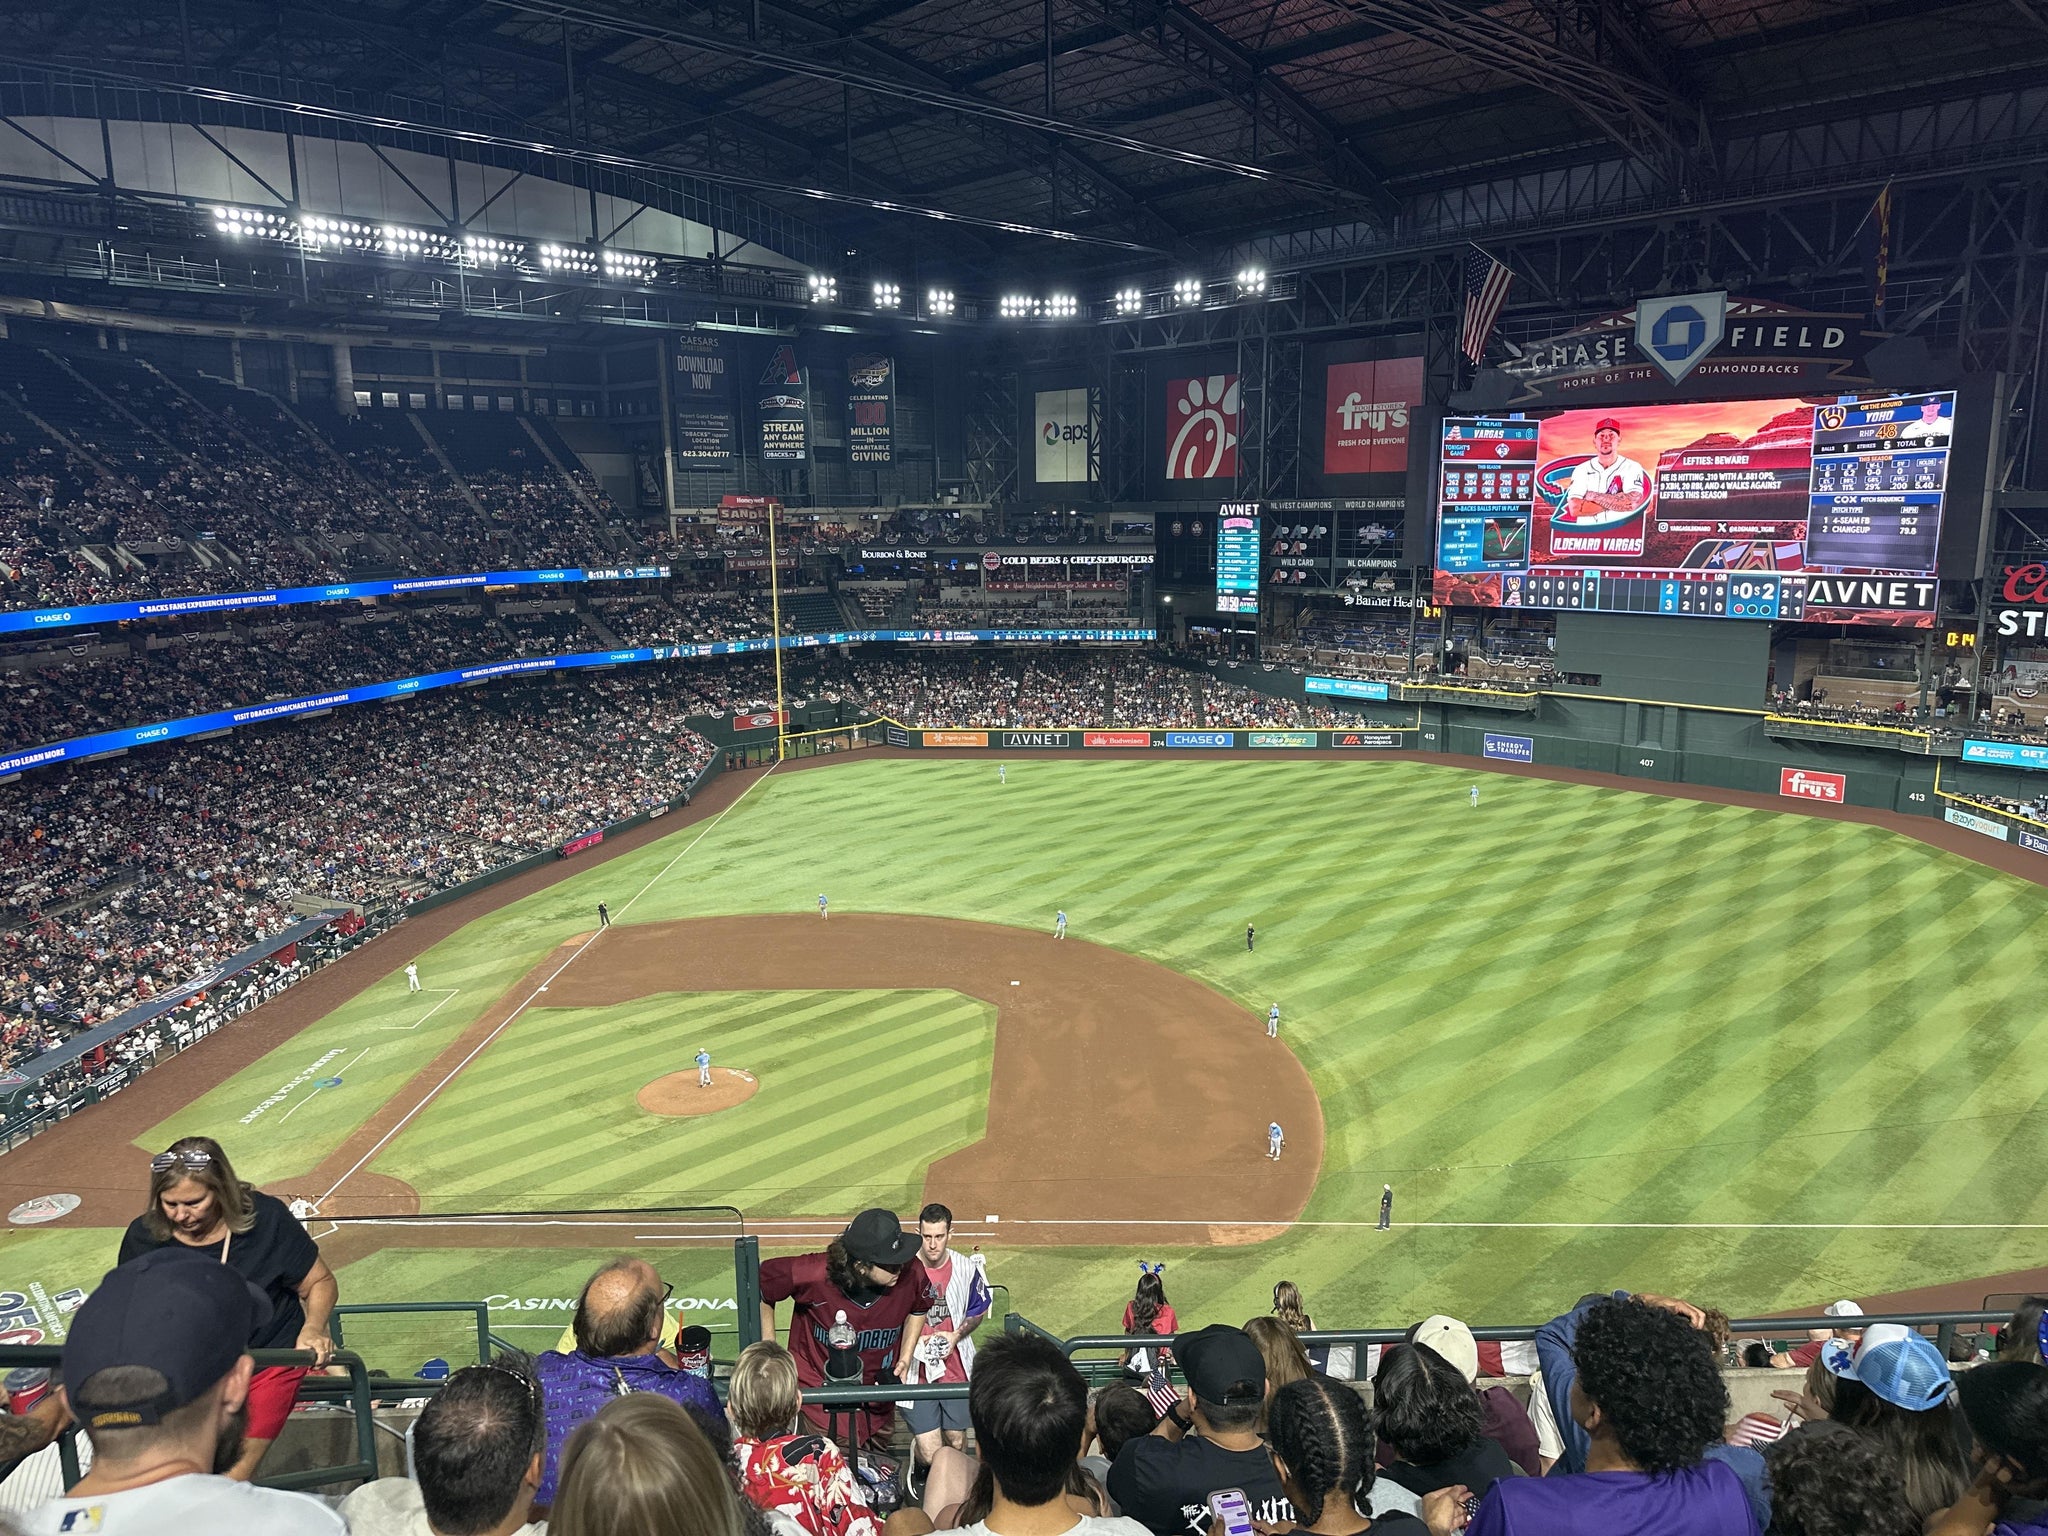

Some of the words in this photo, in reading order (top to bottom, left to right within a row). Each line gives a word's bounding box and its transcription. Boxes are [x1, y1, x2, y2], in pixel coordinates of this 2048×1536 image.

[679, 336, 718, 347] CAESARS
[1531, 337, 1626, 369] CHASE
[1730, 326, 1845, 348] FIELD
[677, 355, 724, 374] DOWNLOAD
[691, 373, 712, 390] NOW
[1563, 377, 1596, 388] HOME
[1604, 373, 1619, 382] OF
[1630, 369, 1651, 379] THE
[1699, 364, 1799, 374] DIAMONDBACKS
[1337, 391, 1409, 433] fry's
[1866, 411, 1895, 423] YOHO
[762, 423, 805, 433] STREAM
[850, 427, 890, 436] MILLION
[1859, 429, 1874, 438] RHP
[1875, 424, 1898, 439] 48
[763, 433, 780, 441] ANY
[782, 433, 805, 441] GAME
[1062, 423, 1089, 445] aps
[1474, 429, 1505, 439] VARGAS
[1373, 437, 1406, 446] EVERYONE
[1843, 444, 1849, 453] 1
[1883, 440, 1891, 450] 5
[1924, 437, 1934, 447] 6
[851, 451, 891, 462] GIVING
[1683, 456, 1713, 466] LEFTIES:
[1714, 455, 1749, 465] BEWARE!
[1661, 473, 1670, 482] HE
[1678, 473, 1703, 482] HITTING
[1719, 472, 1737, 481] WITH
[1758, 471, 1775, 482] OPS,
[1682, 482, 1690, 490] 20
[1707, 481, 1719, 490] AND
[1726, 480, 1746, 490] WALKS
[1747, 480, 1781, 490] AGAINST
[1660, 491, 1684, 500] LEFTIES
[1684, 490, 1699, 499] THIS
[1700, 490, 1728, 499] SEASON
[736, 497, 765, 505] Honeywell
[1296, 501, 1333, 509] CHAMPIONS
[1367, 500, 1405, 508] CHAMPIONS
[1219, 504, 1260, 516] AVNET
[1831, 526, 1871, 534] CHANGEUP
[1553, 539, 1598, 552] ILDEMARO
[1602, 538, 1642, 551] VARGAS
[895, 550, 903, 559] &
[1002, 556, 1027, 565] COLD
[1029, 556, 1061, 565] BEERS
[1062, 556, 1069, 565] &
[1070, 555, 1154, 565] CHEESEBURGERS
[1281, 558, 1296, 567] WILD
[1297, 558, 1314, 566] CARD
[1356, 560, 1398, 568] CHAMPIONS
[588, 571, 604, 579] 8:13
[605, 570, 619, 578] PM
[1714, 573, 1727, 581] LOB
[1529, 580, 1536, 590] 0
[1543, 581, 1550, 590] 0
[1558, 581, 1565, 590] 0
[1572, 581, 1579, 591] 0
[1587, 581, 1594, 592] 2
[1666, 584, 1674, 595] 2
[1684, 585, 1691, 595] 7
[1700, 586, 1707, 596] 0
[1715, 586, 1724, 597] 8
[2003, 564, 2048, 603] Co
[1733, 586, 1739, 596] B
[1740, 581, 1752, 599] 0
[1754, 586, 1761, 596] S
[1762, 582, 1775, 601] 2
[1781, 589, 1789, 599] 2
[1794, 589, 1803, 599] 4
[1806, 580, 1934, 607] AVNET
[139, 603, 169, 614] D-BACKS
[169, 602, 186, 611] FANS
[186, 599, 224, 610] EXPERIENCE
[224, 597, 241, 607] MORE
[241, 596, 258, 605] WITH
[258, 595, 277, 604] CHASE
[1355, 595, 1391, 606] Banner
[1392, 596, 1427, 608] Heath
[1528, 595, 1535, 605] 3
[1542, 596, 1549, 606] 0
[1557, 596, 1564, 606] 0
[1571, 596, 1579, 606] 0
[1664, 599, 1673, 611] 3
[1682, 601, 1690, 612] 2
[1699, 602, 1705, 612] 1
[1714, 602, 1723, 613] 0
[1780, 605, 1788, 615] 2
[34, 613, 63, 623] CHASE
[1998, 610, 2048, 636] ST
[1946, 632, 1975, 647] 0:14
[397, 682, 414, 690] CHASE
[234, 711, 250, 721] VISIT
[250, 700, 307, 718] DBACKS.COM/CHASE
[307, 699, 315, 707] TO
[315, 696, 333, 706] LEARN
[333, 694, 349, 702] MORE
[136, 729, 161, 740] CHASE
[1010, 733, 1062, 745] AVNET
[1174, 735, 1212, 744] CHASE
[1424, 733, 1435, 741] 413
[1496, 740, 1524, 750] ENERGY
[9, 758, 21, 767] TO
[21, 752, 44, 765] LEARN
[44, 747, 66, 760] MORE
[1496, 747, 1531, 756] TRANSFER
[2020, 749, 2045, 758] GET
[1640, 759, 1654, 767] 407
[1787, 772, 1837, 798] fry's
[1909, 791, 1925, 802] 413
[2032, 839, 2048, 852] Ban
[97, 1083, 109, 1092] PIT
[109, 1071, 128, 1086] BOSS
[664, 1298, 739, 1311] ZONA
